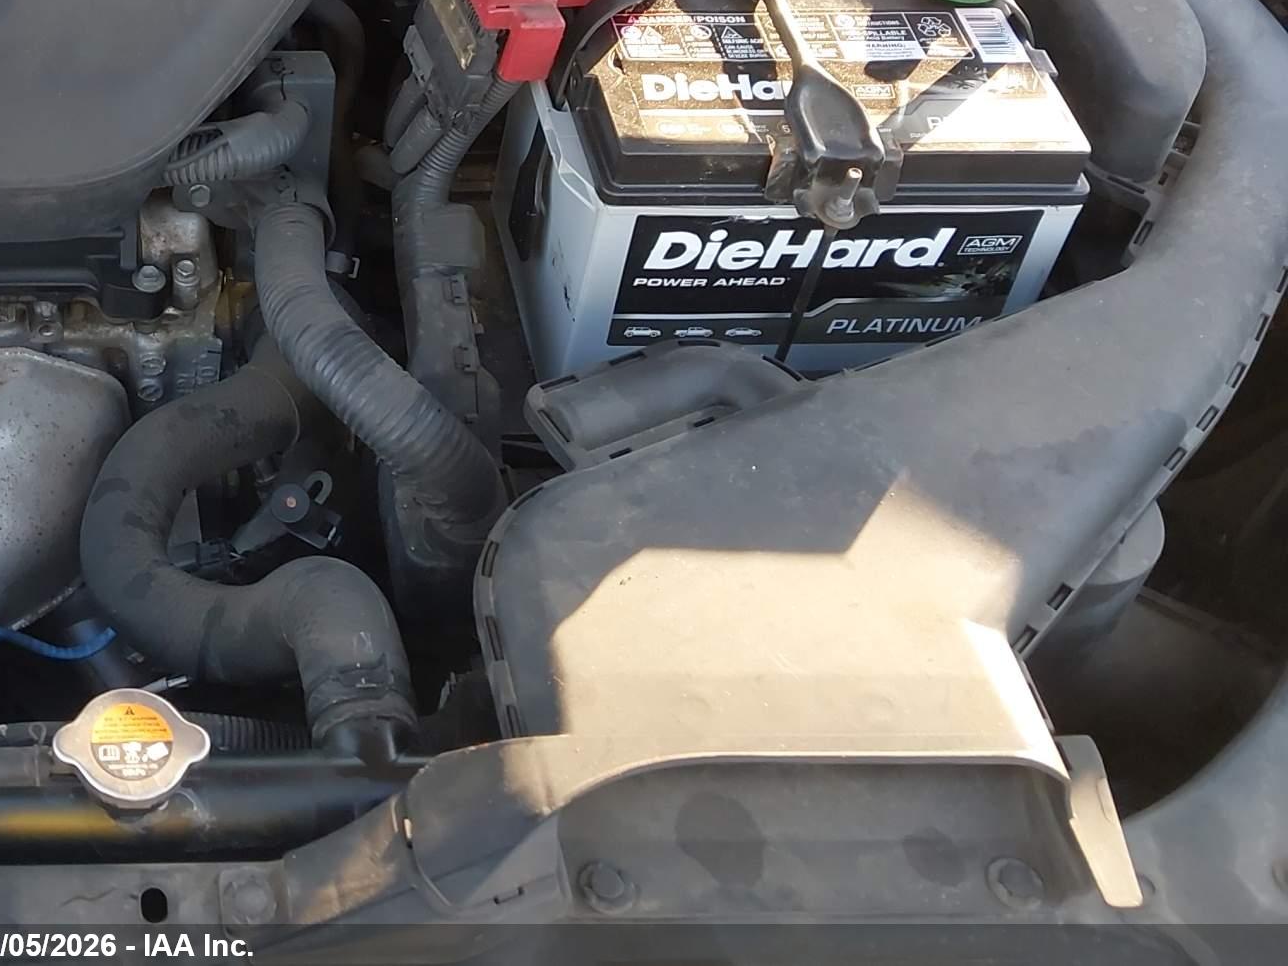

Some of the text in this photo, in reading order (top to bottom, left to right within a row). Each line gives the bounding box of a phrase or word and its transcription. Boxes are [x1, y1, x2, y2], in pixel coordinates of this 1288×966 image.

[966, 237, 1017, 247] AGM
[642, 227, 956, 272] DieHard
[632, 277, 787, 288] POWER AHEAD
